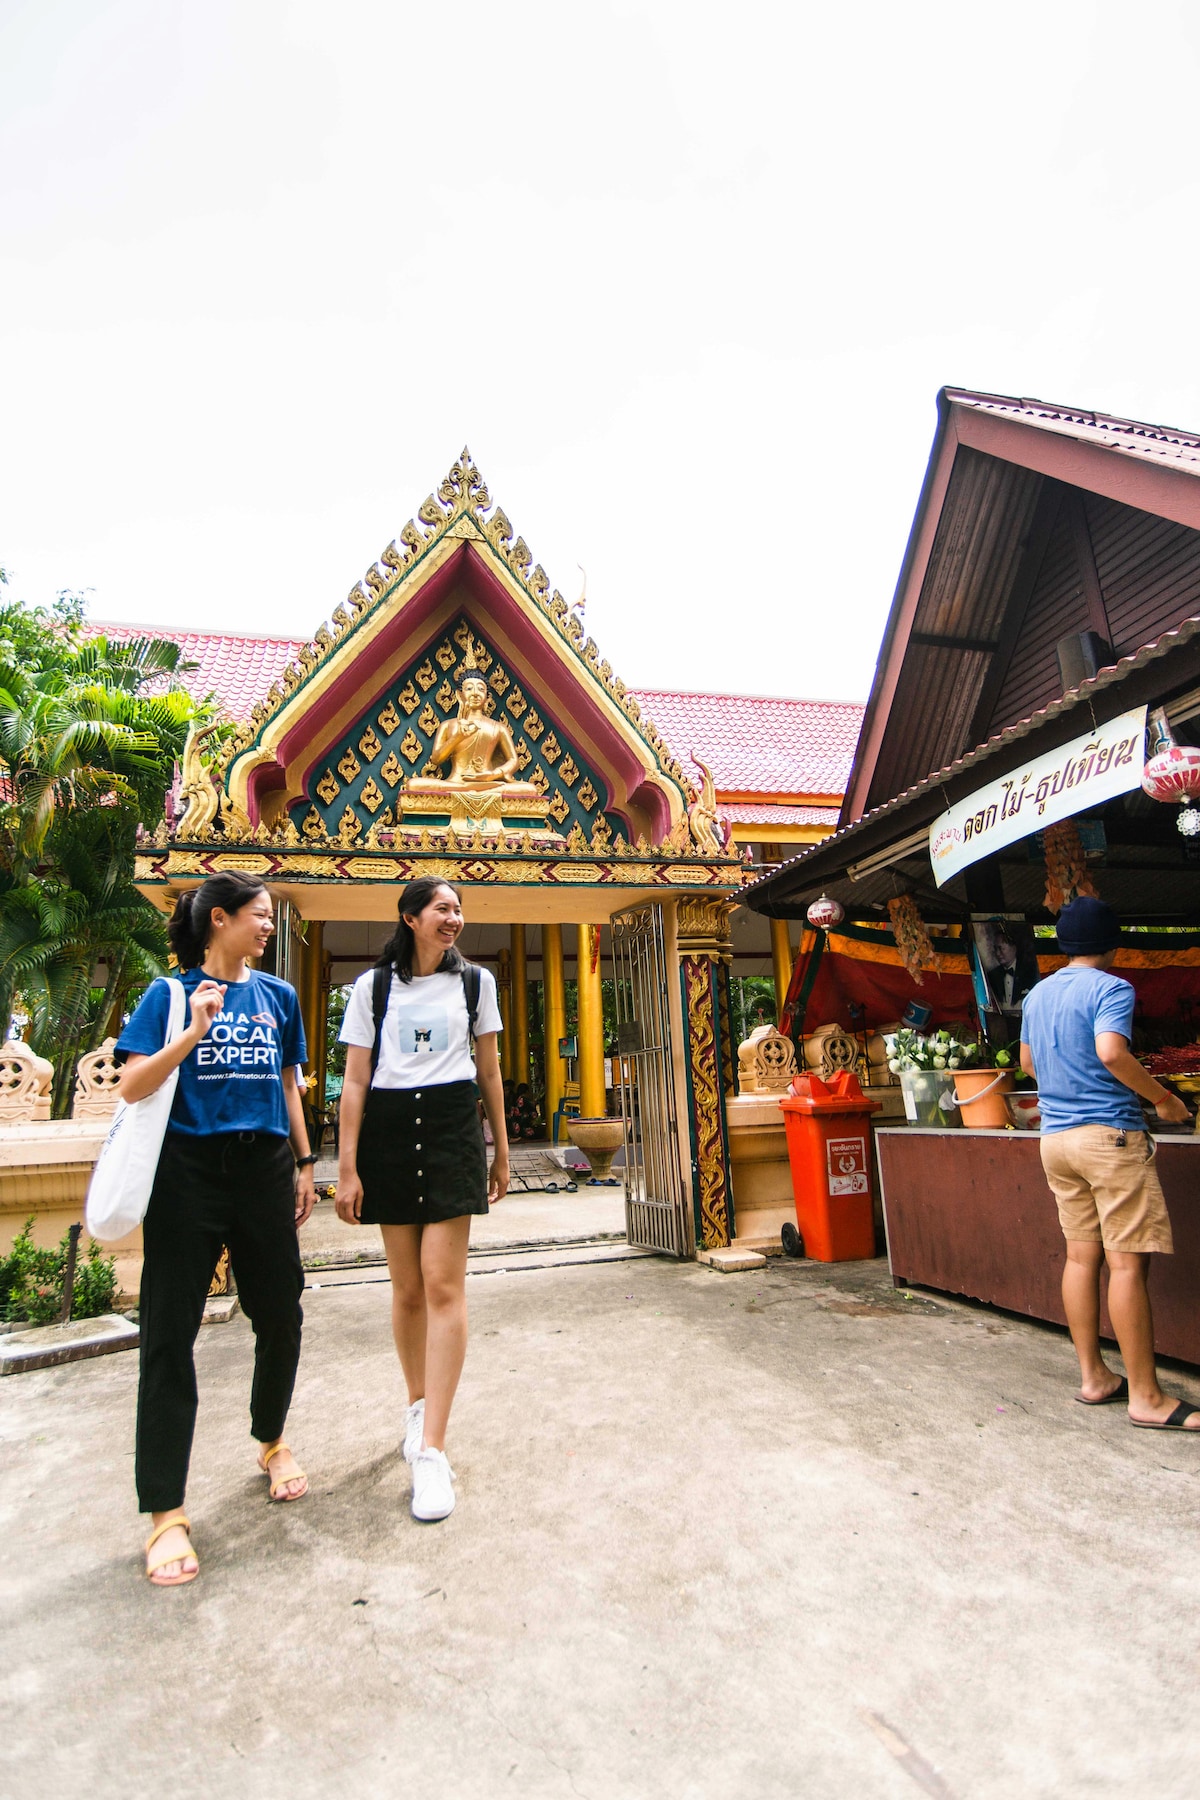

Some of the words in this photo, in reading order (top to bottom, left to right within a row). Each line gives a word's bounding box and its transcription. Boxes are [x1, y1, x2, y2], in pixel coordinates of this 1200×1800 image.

[964, 734, 1139, 842] ดอกไม้-ธูปเทียน
[237, 1012, 250, 1024] A
[197, 1046, 278, 1065] EXPERT
